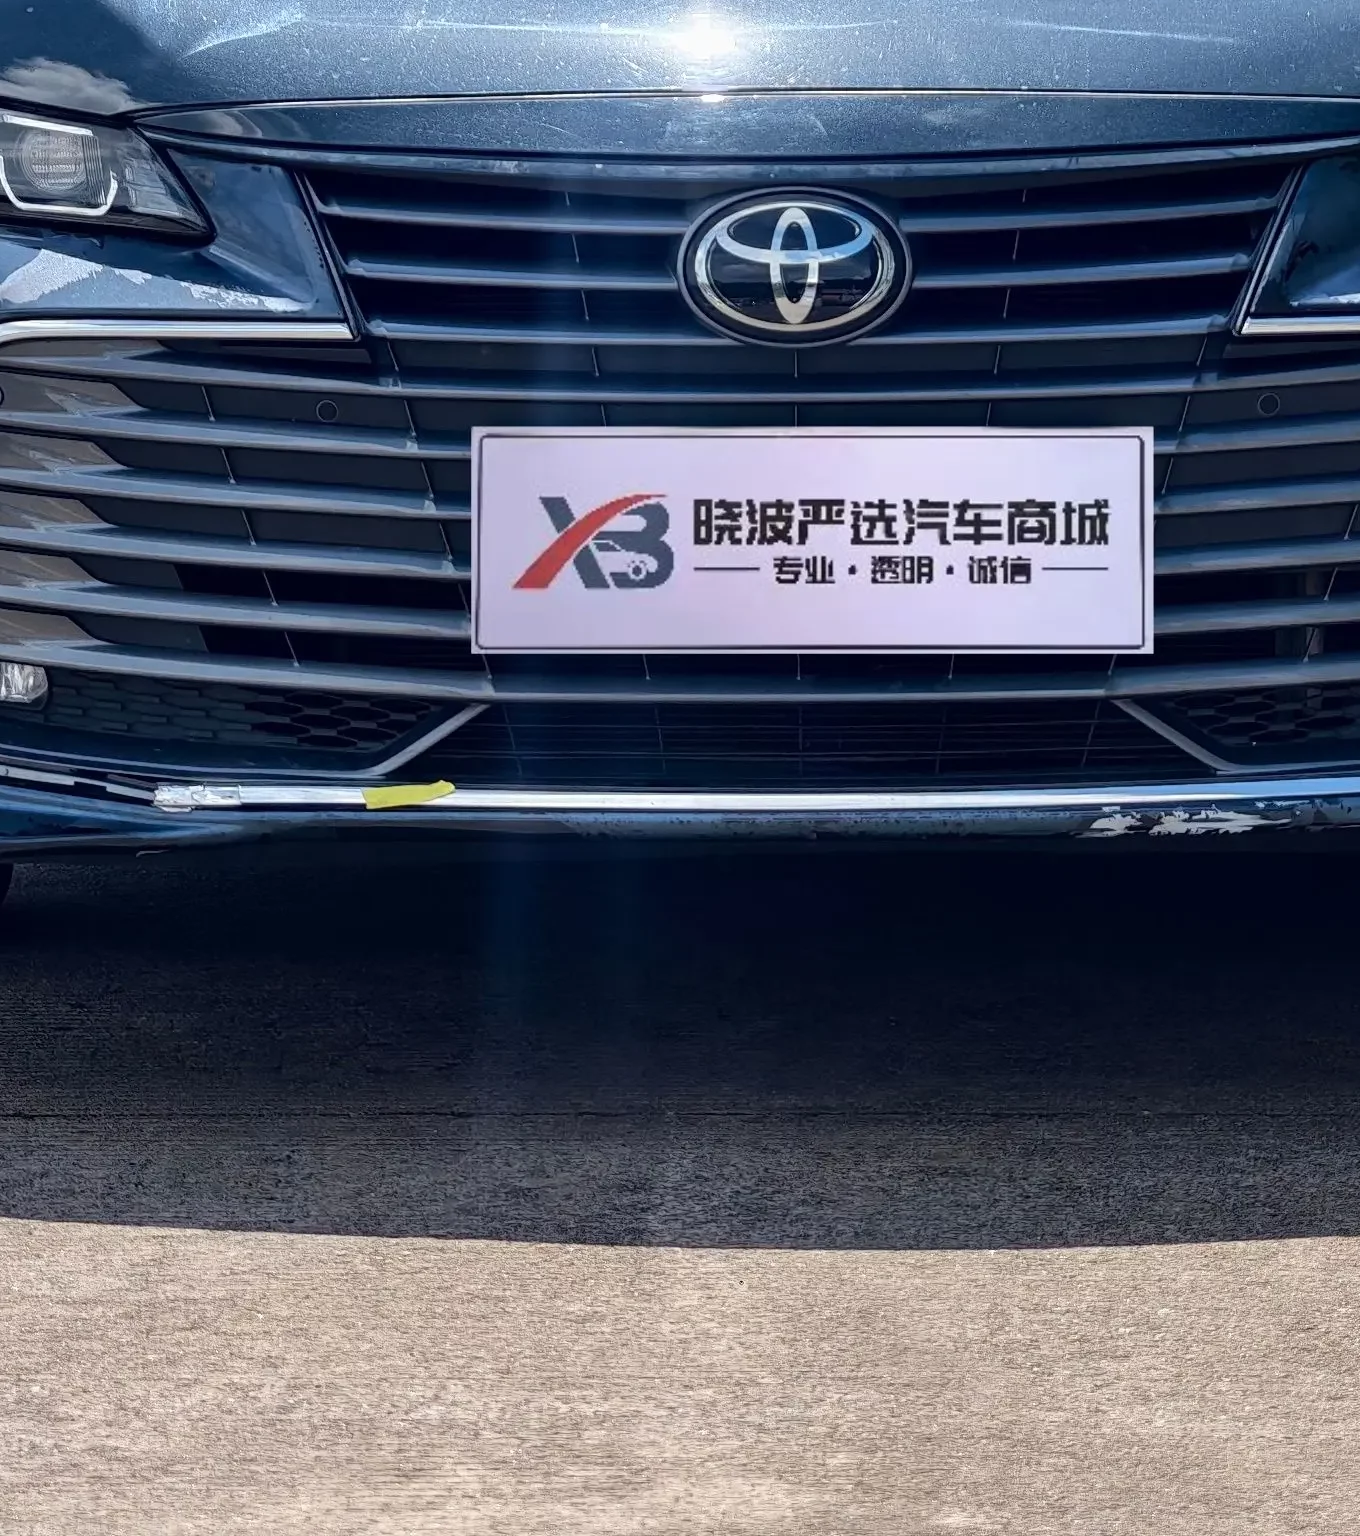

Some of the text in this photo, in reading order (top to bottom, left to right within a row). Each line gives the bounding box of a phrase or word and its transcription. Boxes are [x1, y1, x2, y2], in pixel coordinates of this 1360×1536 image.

[693, 498, 1110, 546] 晓波严选汽车商城
